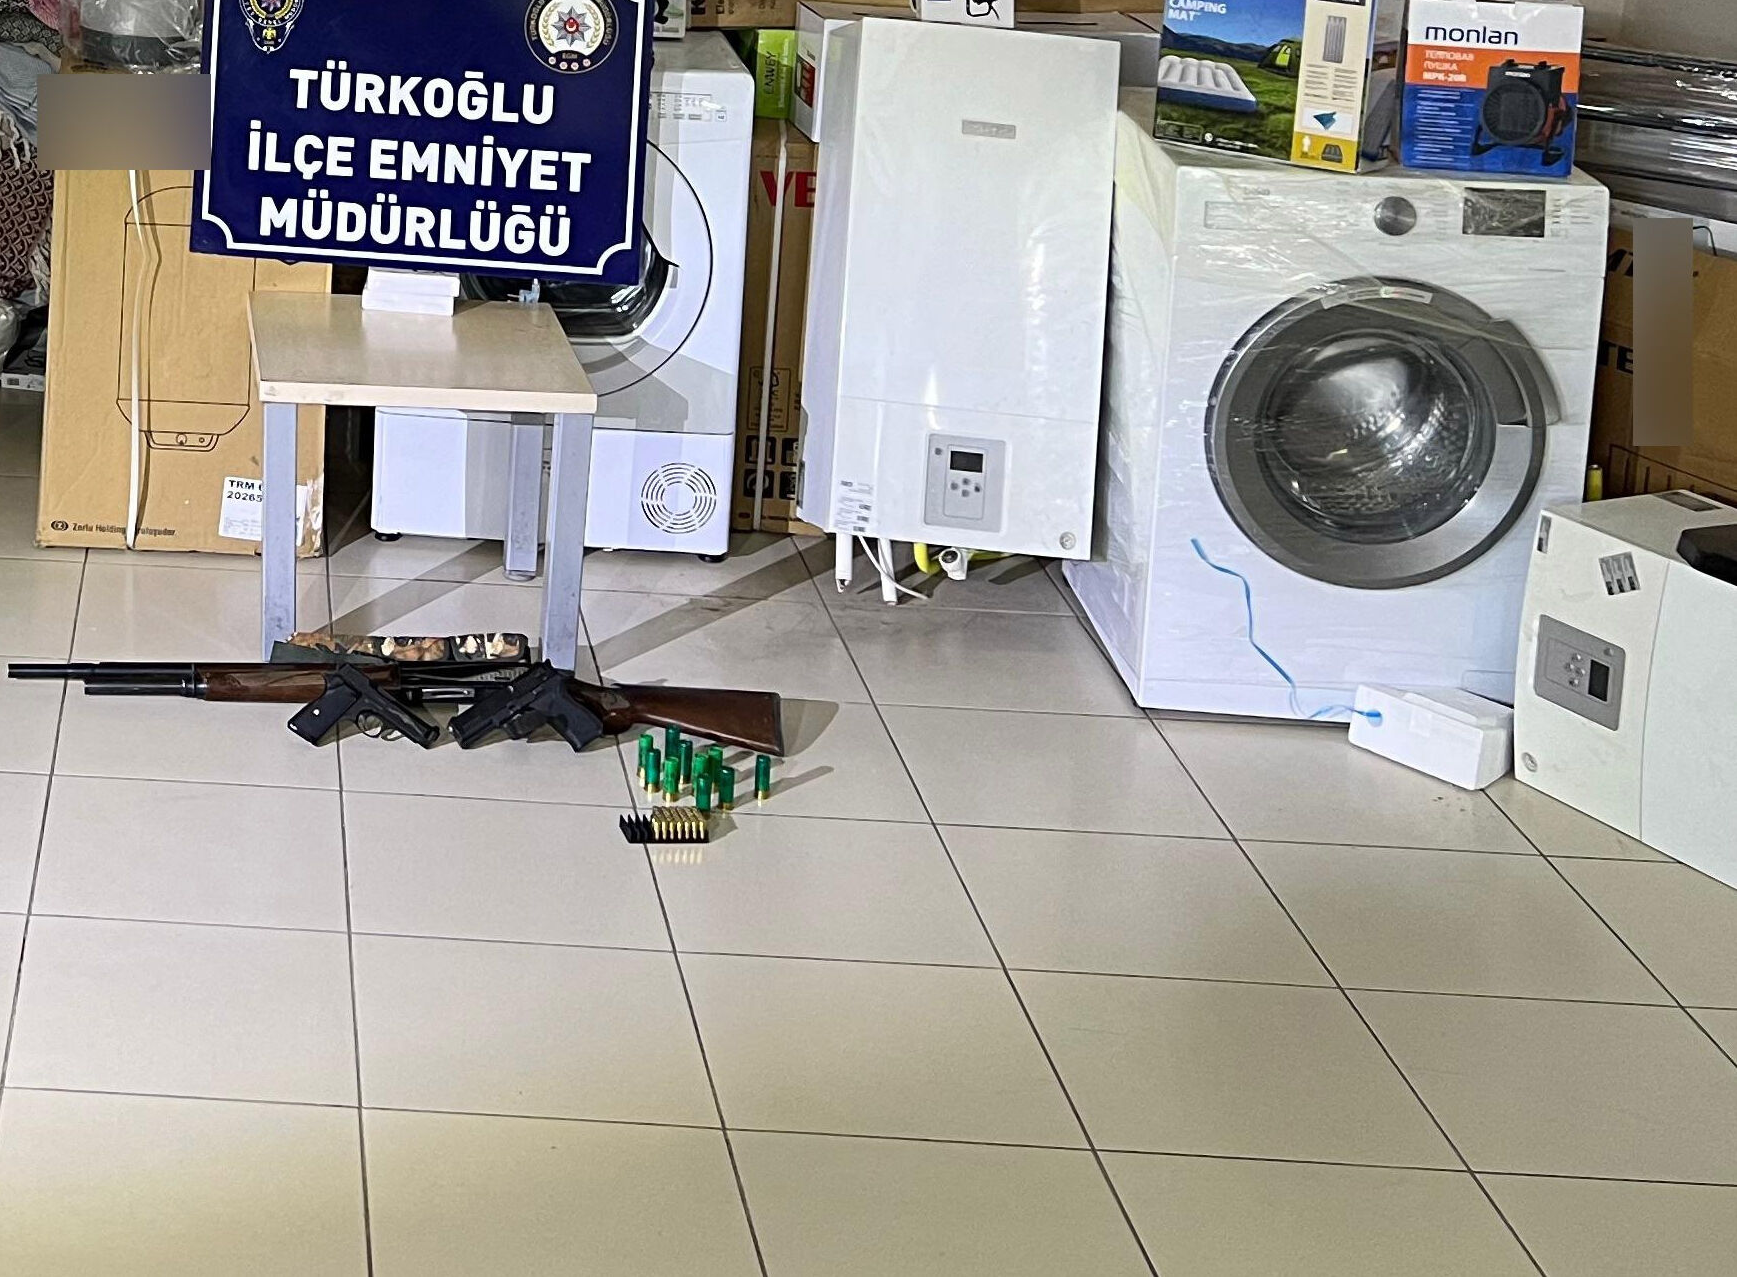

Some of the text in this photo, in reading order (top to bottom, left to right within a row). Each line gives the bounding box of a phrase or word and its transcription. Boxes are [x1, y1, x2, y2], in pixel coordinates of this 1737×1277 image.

[1424, 25, 1519, 46] monlan
[288, 59, 555, 125] TÜRKOĞLU
[247, 119, 592, 193] İLÇE EMNİYET
[759, 170, 817, 208] VE
[260, 188, 571, 258] MÜDÜRLÜĞÜ
[228, 479, 255, 490] TRM
